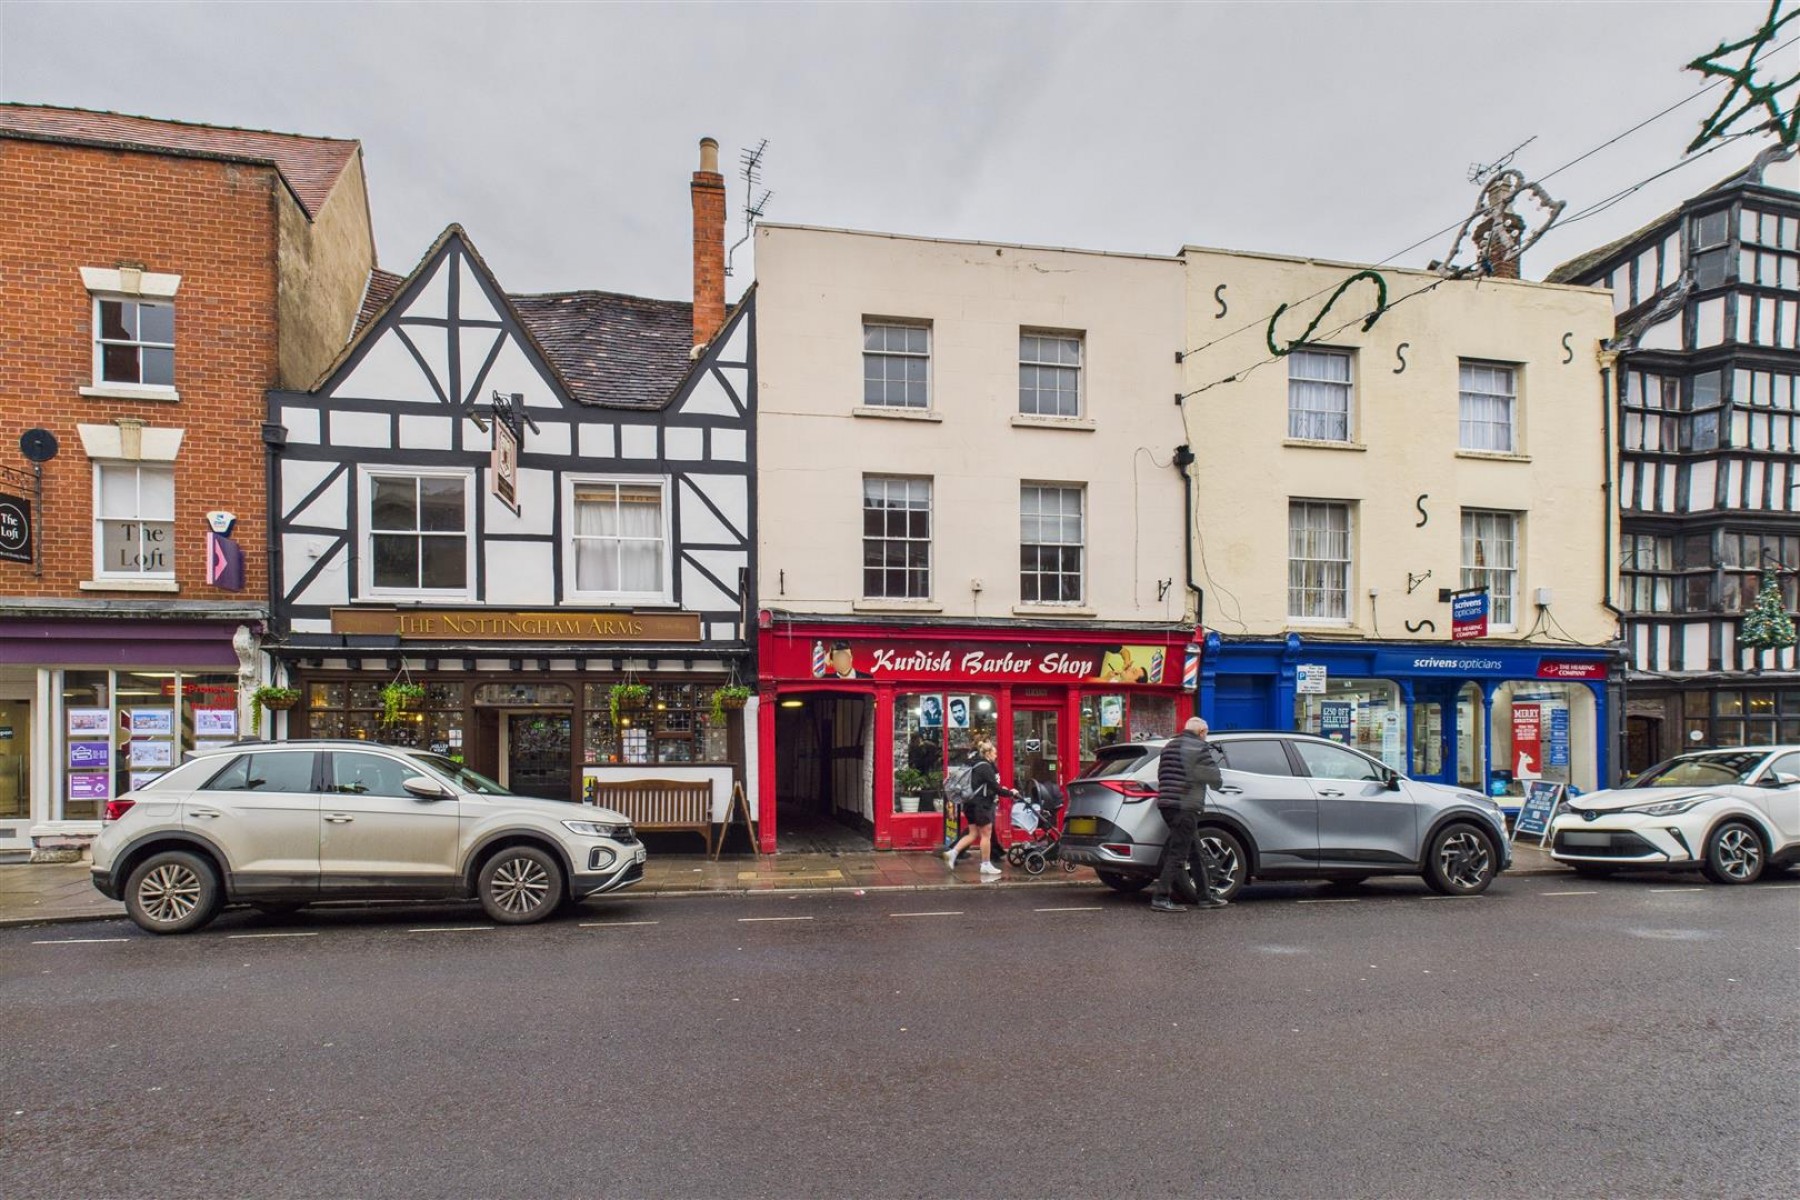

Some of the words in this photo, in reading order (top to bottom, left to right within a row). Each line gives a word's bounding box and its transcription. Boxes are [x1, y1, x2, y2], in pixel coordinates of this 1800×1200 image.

[1, 513, 18, 526] The
[1, 526, 19, 540] Loft
[121, 523, 165, 541] The
[121, 548, 165, 570] Loft
[1454, 599, 1482, 610] scrivens
[1454, 607, 1482, 618] opticians
[395, 614, 436, 634] THE
[443, 615, 580, 635] NOTTINGHAM
[588, 617, 643, 636] ARMS
[870, 649, 952, 673] Kurdish
[961, 650, 1032, 675] Barber
[1038, 652, 1093, 679] Shop
[1413, 657, 1458, 668] scrivens
[1459, 658, 1503, 670] opticians
[1570, 663, 1596, 671] HEARING
[1558, 669, 1587, 677] COMPANY
[1338, 707, 1350, 716] OFF
[1513, 709, 1539, 718] MERRY
